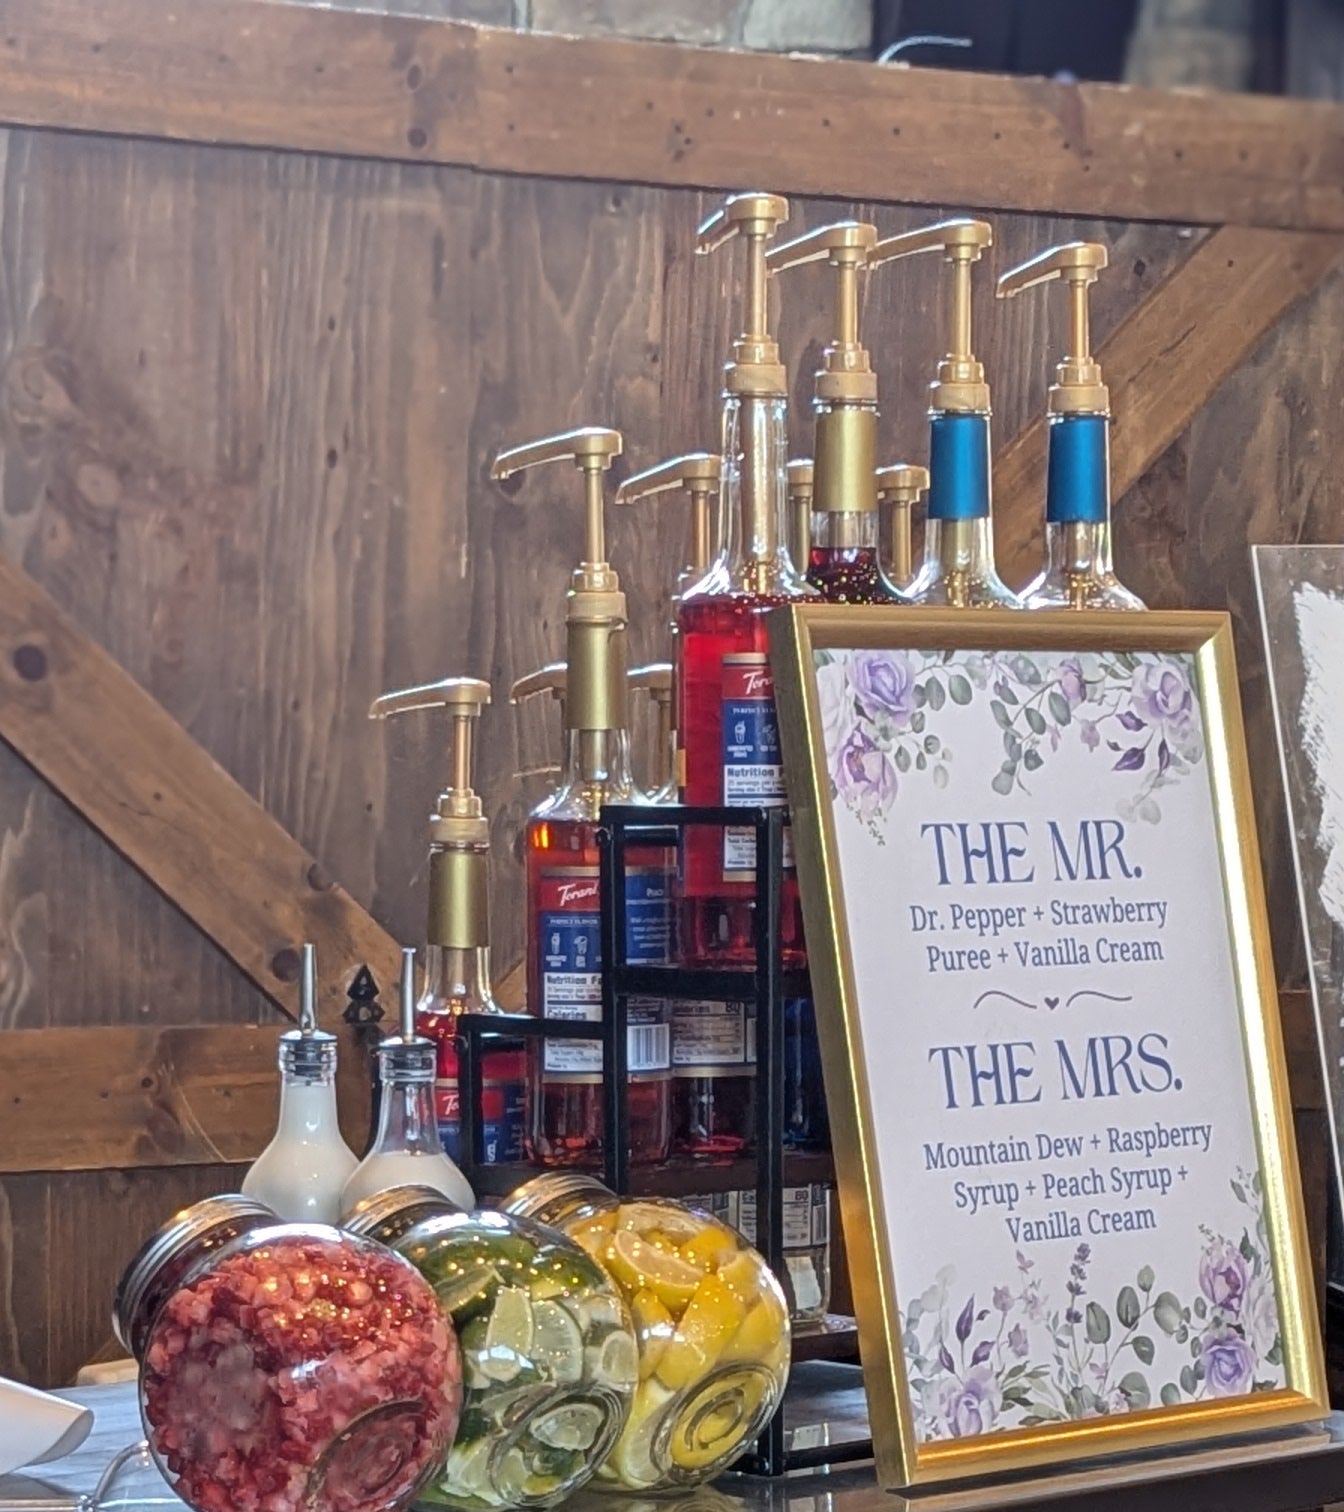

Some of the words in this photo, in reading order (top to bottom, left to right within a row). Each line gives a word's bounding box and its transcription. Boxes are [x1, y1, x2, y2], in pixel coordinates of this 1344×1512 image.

[921, 822, 1034, 885] THE
[1047, 820, 1142, 881] MR.
[910, 906, 944, 931] Dr.
[950, 904, 1026, 936] Pepper
[1050, 898, 1167, 928] Strawberry
[926, 946, 991, 972] Puree
[1014, 938, 1091, 966] Vanilla
[1096, 938, 1164, 963] Cream
[928, 1042, 1042, 1109] THE
[1054, 1034, 1182, 1100] MRS.
[923, 1136, 1032, 1170] Mountain
[1035, 1134, 1083, 1160] Dew
[1107, 1124, 1211, 1158] Raspberry
[954, 1182, 1019, 1215] Syrup
[1042, 1168, 1106, 1199] Peach
[1110, 1167, 1172, 1200] Syrup
[1005, 1211, 1082, 1242] Vanilla
[1088, 1209, 1156, 1234] Cream
